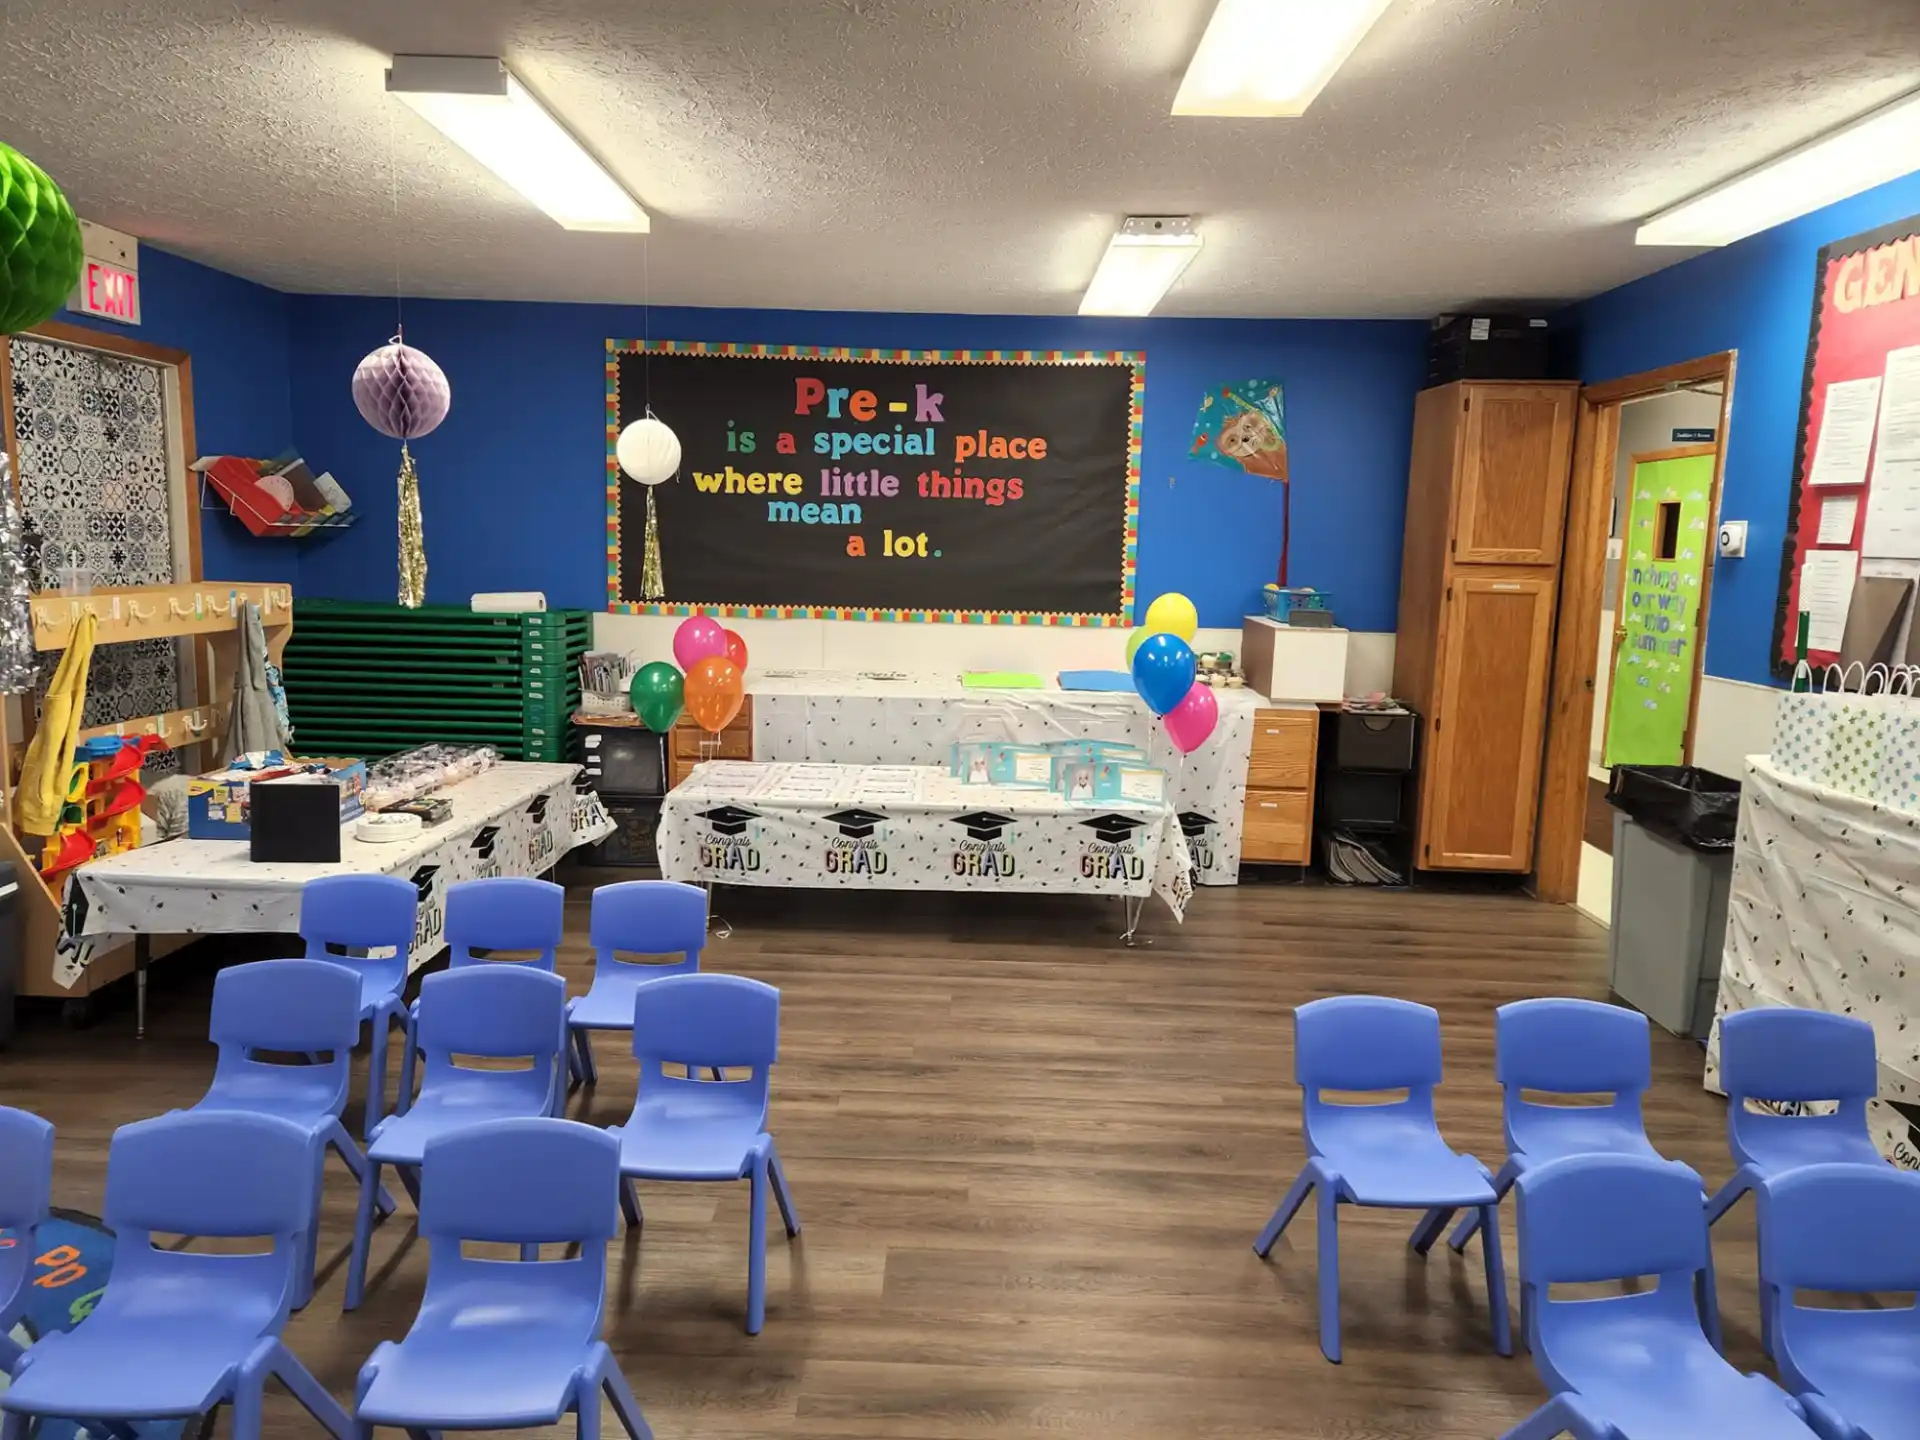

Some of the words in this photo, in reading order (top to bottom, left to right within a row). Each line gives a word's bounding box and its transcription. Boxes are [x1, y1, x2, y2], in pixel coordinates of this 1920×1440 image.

[88, 263, 136, 318] EXIT
[727, 420, 756, 454] is
[776, 431, 796, 454] a
[814, 424, 935, 460] special
[954, 430, 1047, 463] place
[692, 466, 803, 495] where
[820, 467, 899, 497] little
[917, 468, 1024, 506] things
[767, 500, 862, 524] mean
[846, 534, 866, 557] a
[571, 803, 605, 832] GRA
[705, 833, 751, 848] Congrats
[832, 836, 879, 851] Congrats
[959, 839, 1006, 854] Congrats
[1088, 842, 1135, 856] Congrats
[700, 846, 761, 871] GRAD
[826, 849, 887, 874] GRAD
[953, 852, 1015, 877] GRAD
[1080, 854, 1144, 880] GRAD
